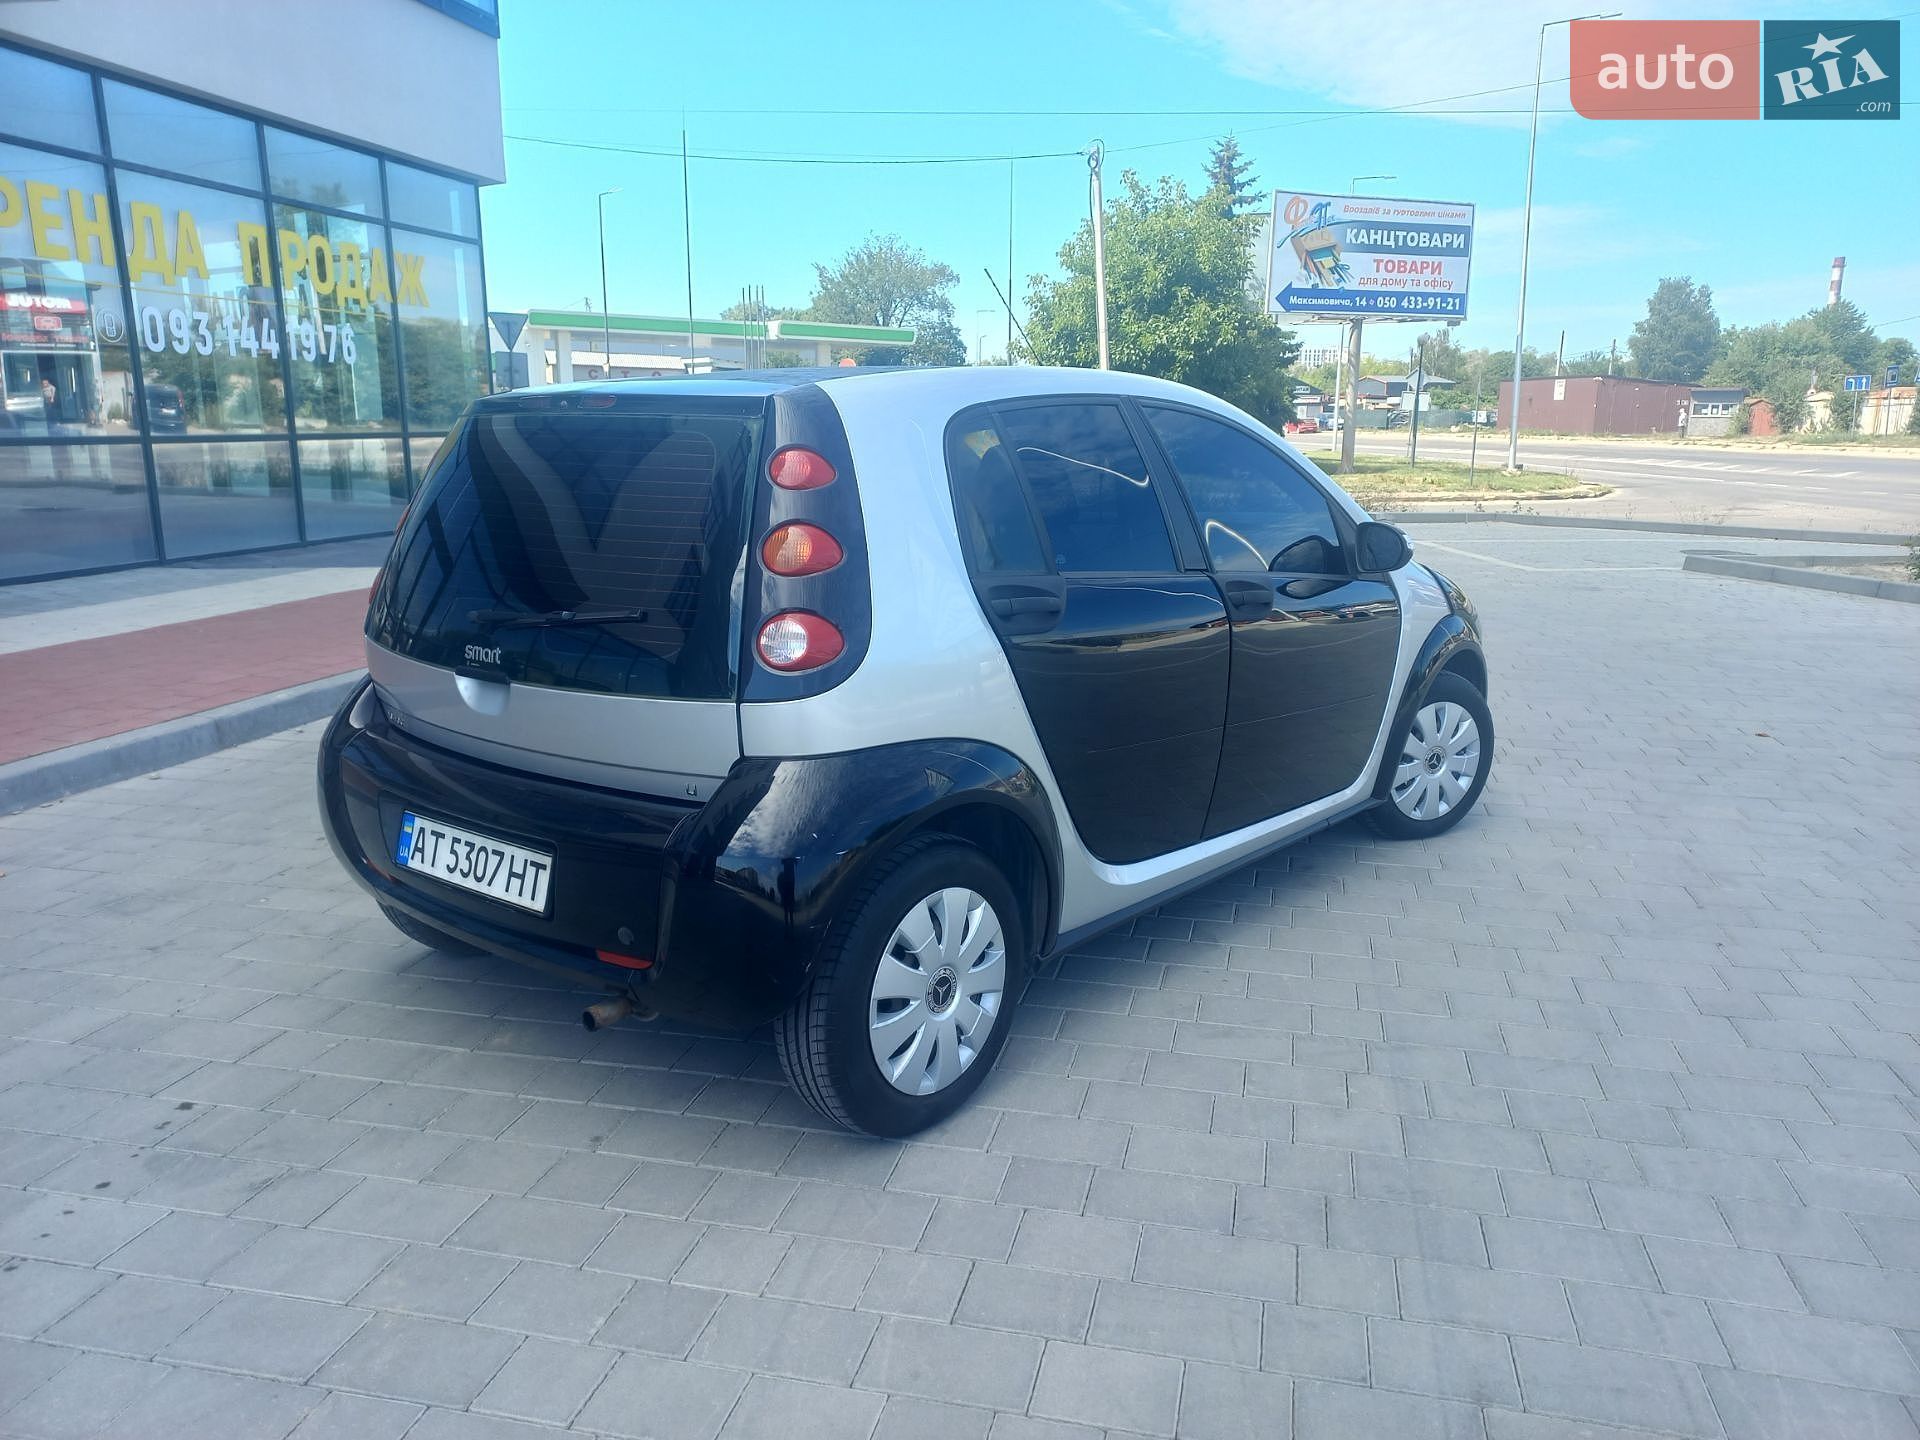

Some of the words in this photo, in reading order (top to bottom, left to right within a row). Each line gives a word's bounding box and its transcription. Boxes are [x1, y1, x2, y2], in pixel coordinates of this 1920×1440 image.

[1345, 228, 1465, 249] КАНЦТОВАРИ
[238, 221, 429, 308] ПРОДАЖ
[1373, 258, 1443, 275] ТОВАРИ
[1358, 278, 1378, 286] для
[1380, 278, 1407, 288] дому
[1410, 279, 1422, 287] та
[1424, 278, 1454, 291] офісу
[1355, 296, 1367, 307] 14
[1376, 296, 1397, 309] 050
[1401, 296, 1460, 311] 433-91-21
[142, 306, 213, 356] 093
[464, 644, 501, 665] smart
[399, 845, 409, 858] UA
[446, 836, 505, 887] 5307
